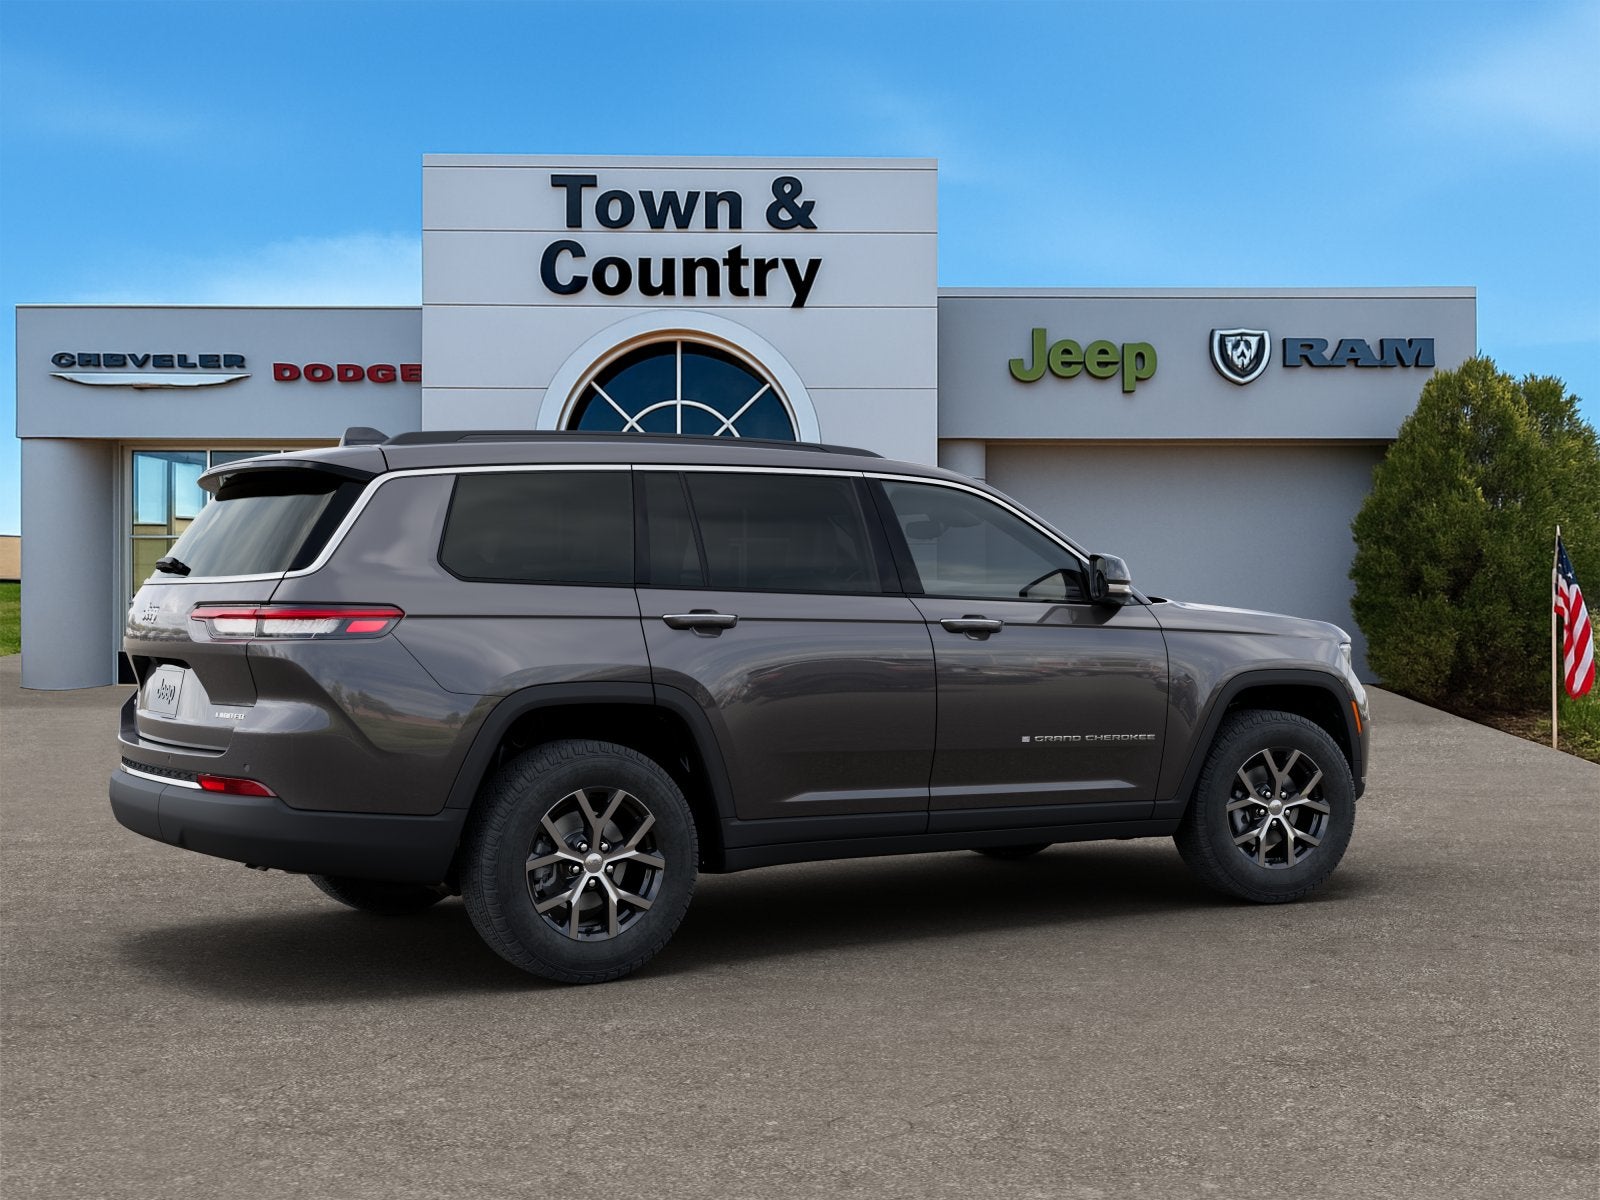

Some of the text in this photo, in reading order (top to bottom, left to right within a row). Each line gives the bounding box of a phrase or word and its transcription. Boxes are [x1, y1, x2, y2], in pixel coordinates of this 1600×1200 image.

[551, 174, 818, 230] Town &
[540, 239, 822, 308] Country
[273, 363, 422, 383] DODGE
[1009, 328, 1157, 393] Jeep
[1282, 337, 1436, 368] RAM
